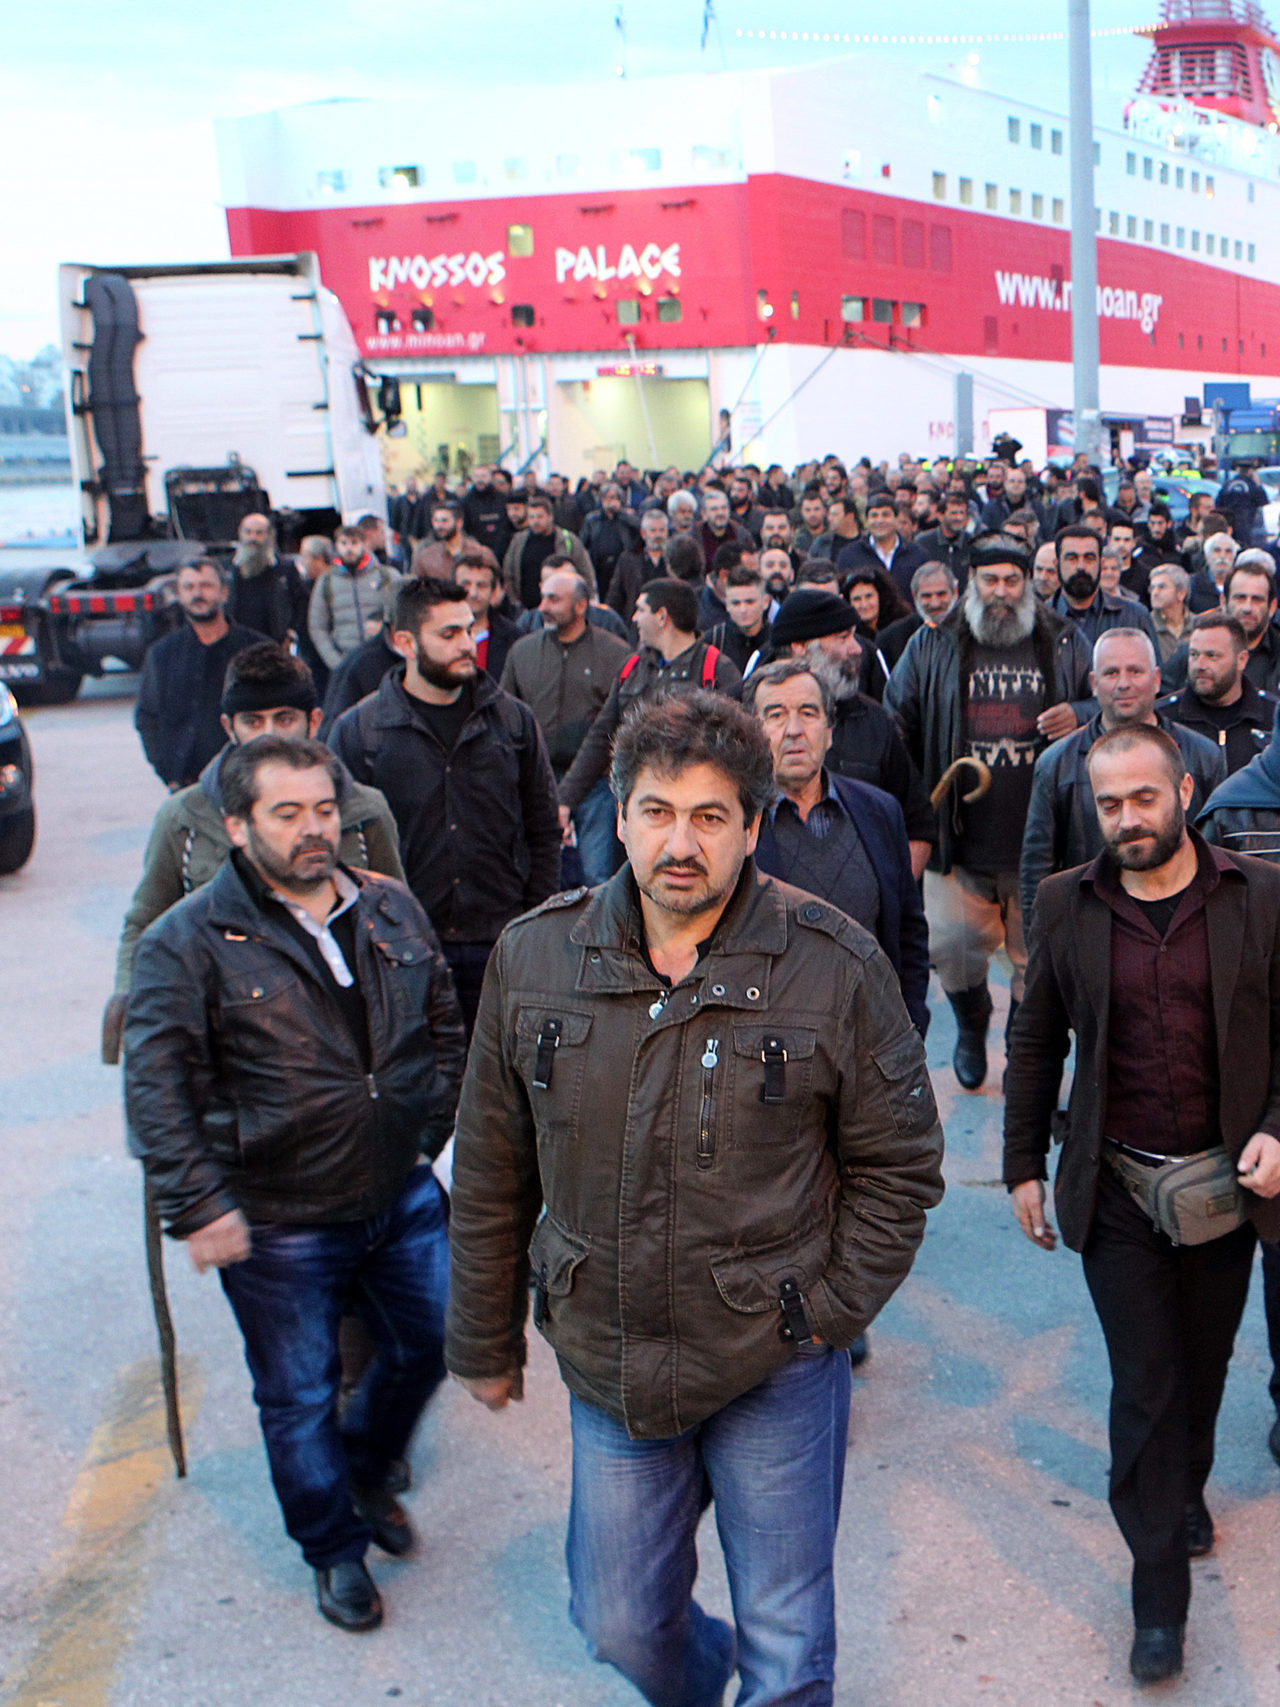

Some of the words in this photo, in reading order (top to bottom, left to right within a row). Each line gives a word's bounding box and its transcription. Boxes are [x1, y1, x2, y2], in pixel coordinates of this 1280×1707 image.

[369, 250, 506, 292] KNOSSOS
[555, 242, 682, 284] PALACE
[365, 331, 486, 351] www.minoan.gr
[967, 664, 1046, 700] NITE
